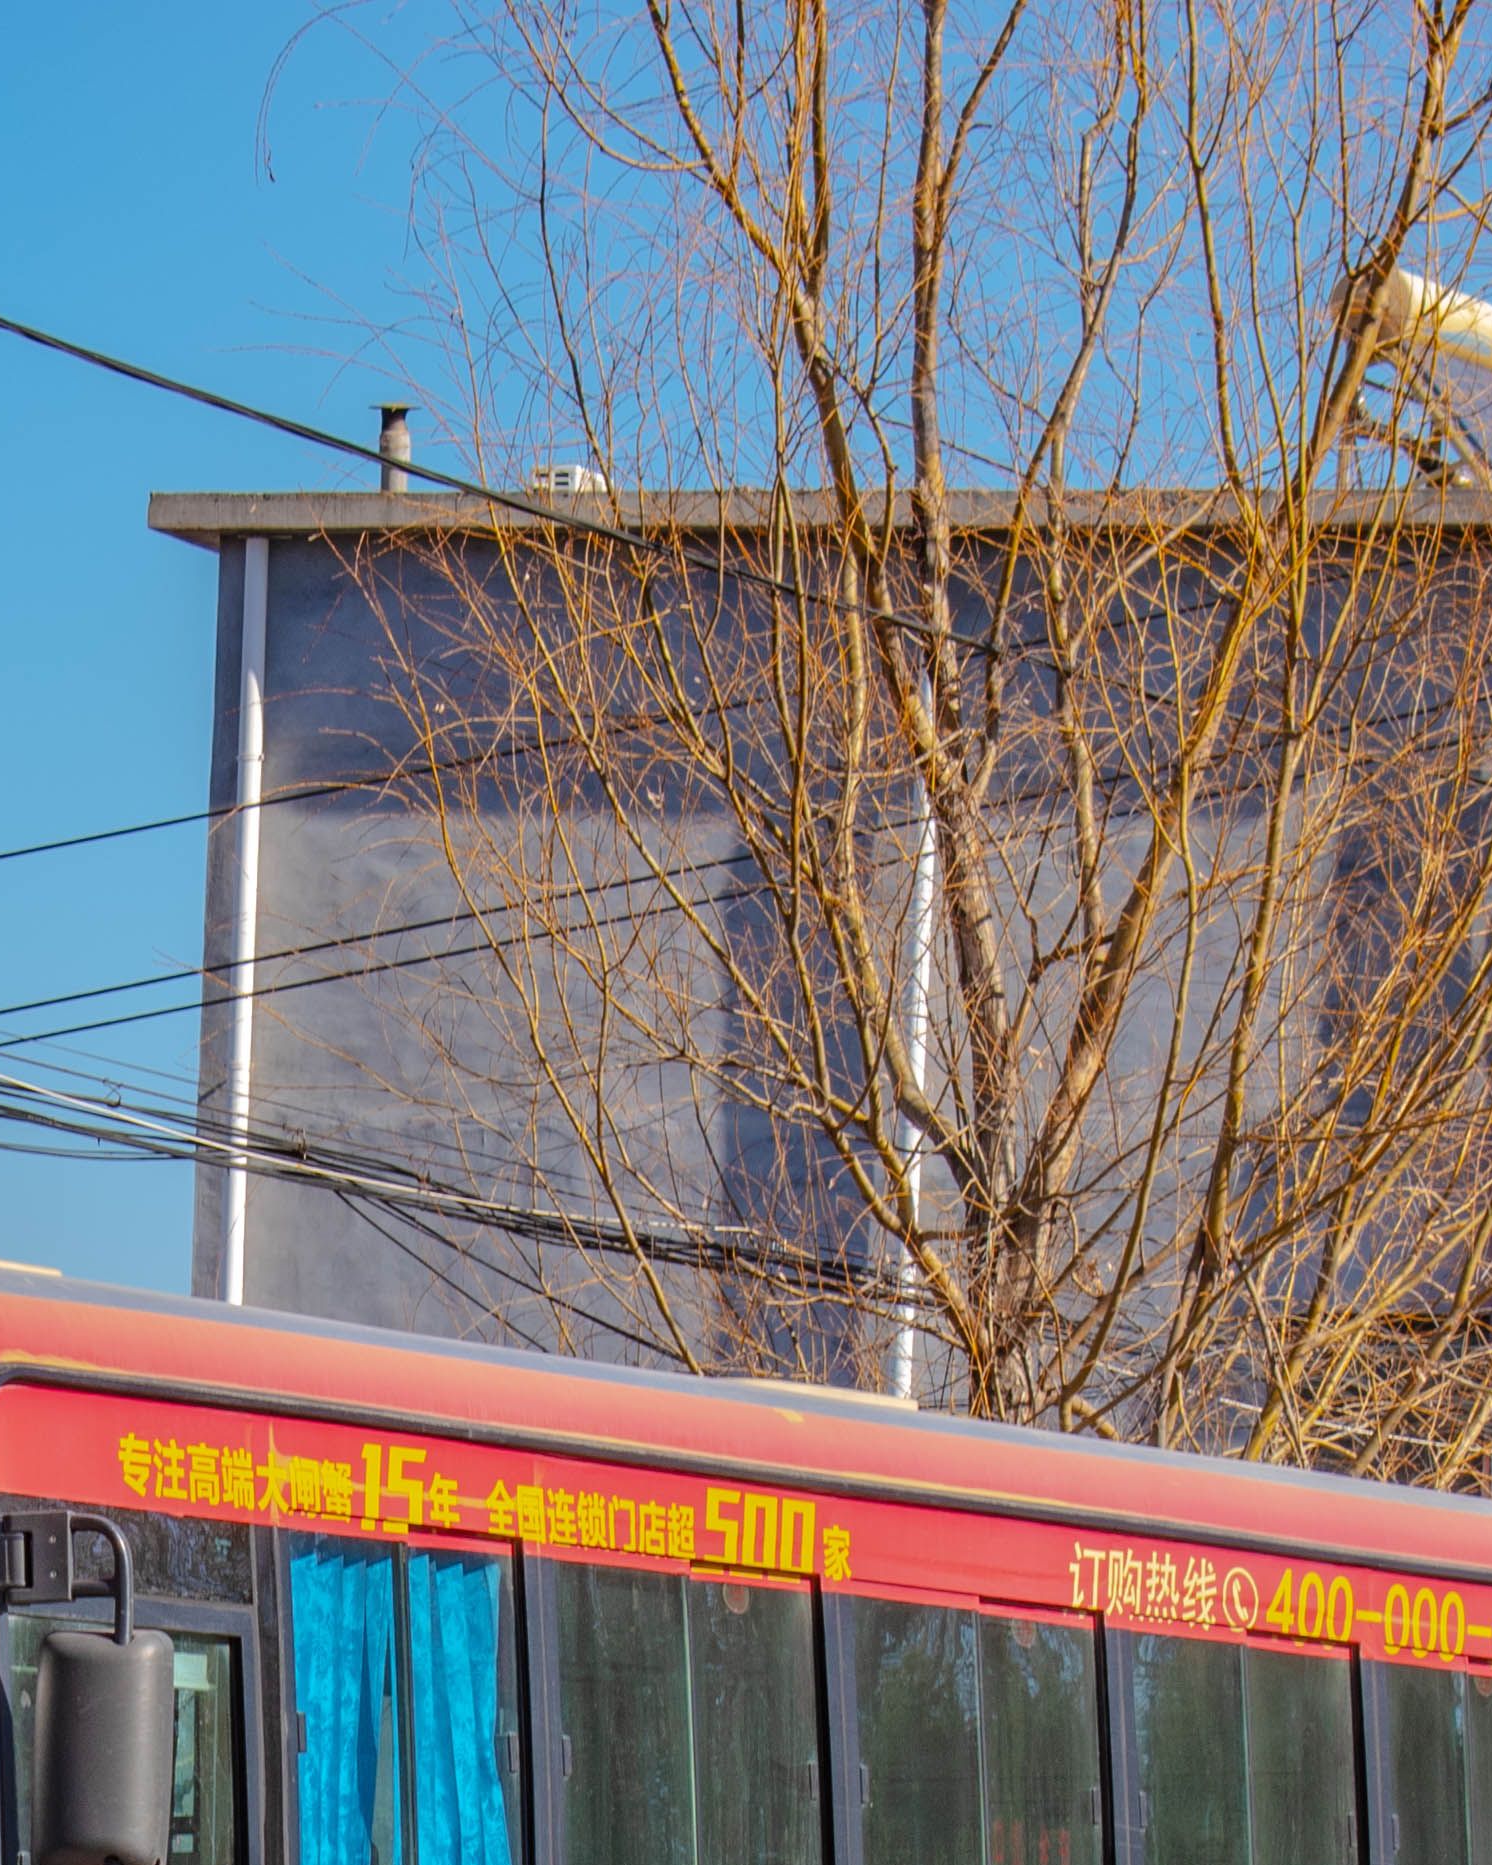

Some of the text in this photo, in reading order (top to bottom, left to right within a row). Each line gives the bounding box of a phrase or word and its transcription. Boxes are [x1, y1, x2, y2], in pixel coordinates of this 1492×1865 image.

[118, 1432, 461, 1535] 专注高端大闸蟹15年
[483, 1479, 852, 1583] 全国连锁门店超500家
[1069, 1541, 1217, 1624] 订购热线
